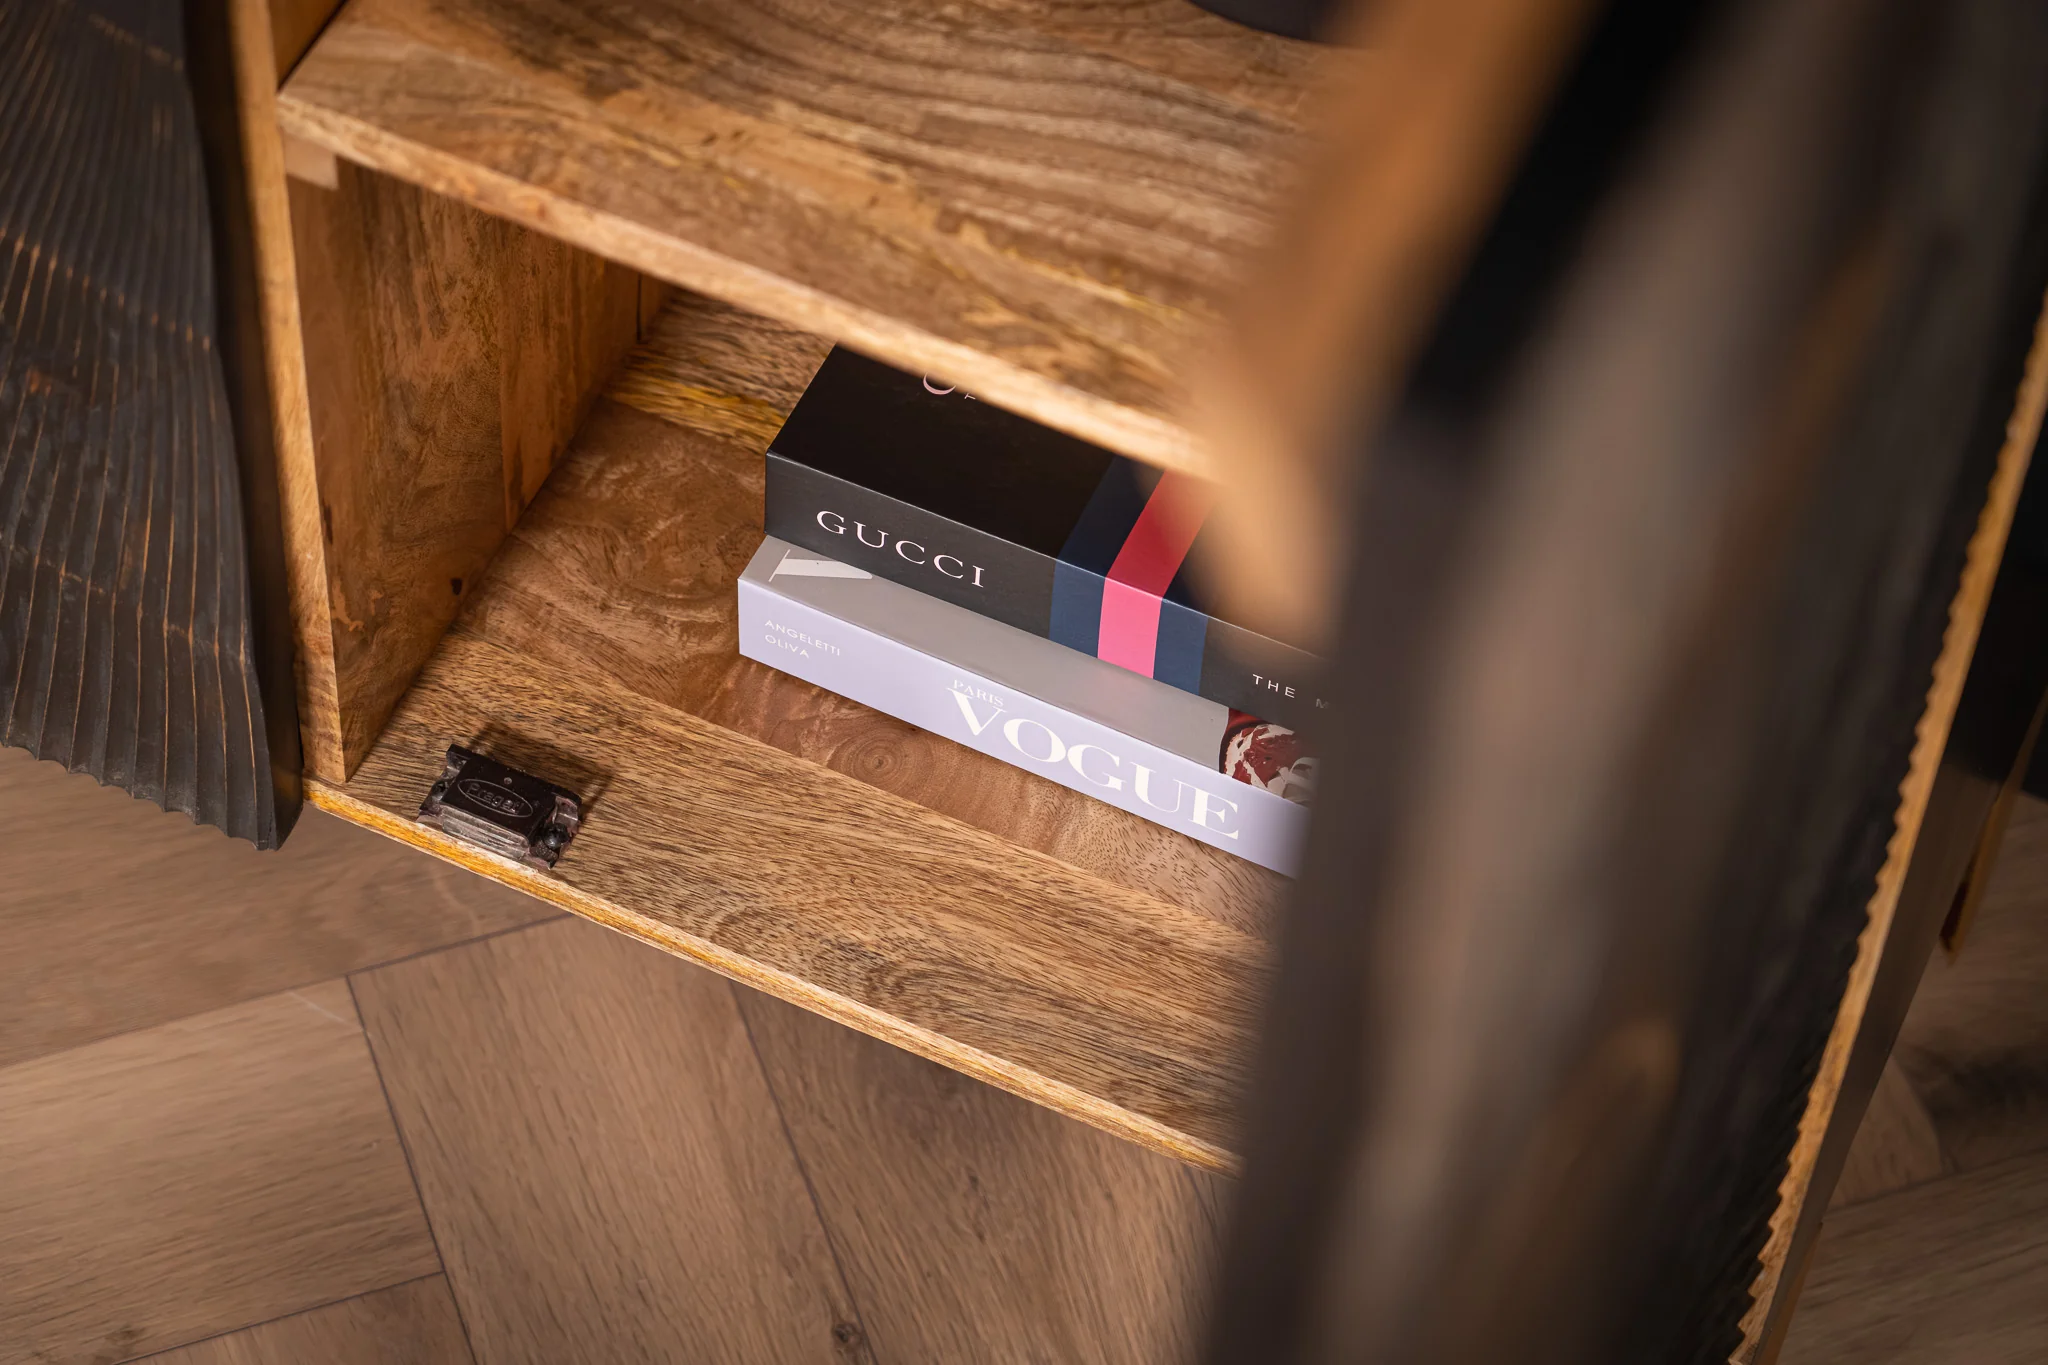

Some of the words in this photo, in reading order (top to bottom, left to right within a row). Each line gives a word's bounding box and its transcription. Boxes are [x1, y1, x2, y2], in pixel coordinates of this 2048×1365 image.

[816, 510, 985, 588] GUCCI
[764, 619, 841, 656] ANGELETTI
[764, 634, 810, 659] OLIVA
[952, 679, 1005, 708] PARIS
[1252, 673, 1296, 698] THE
[945, 687, 1239, 840] VOGUE
